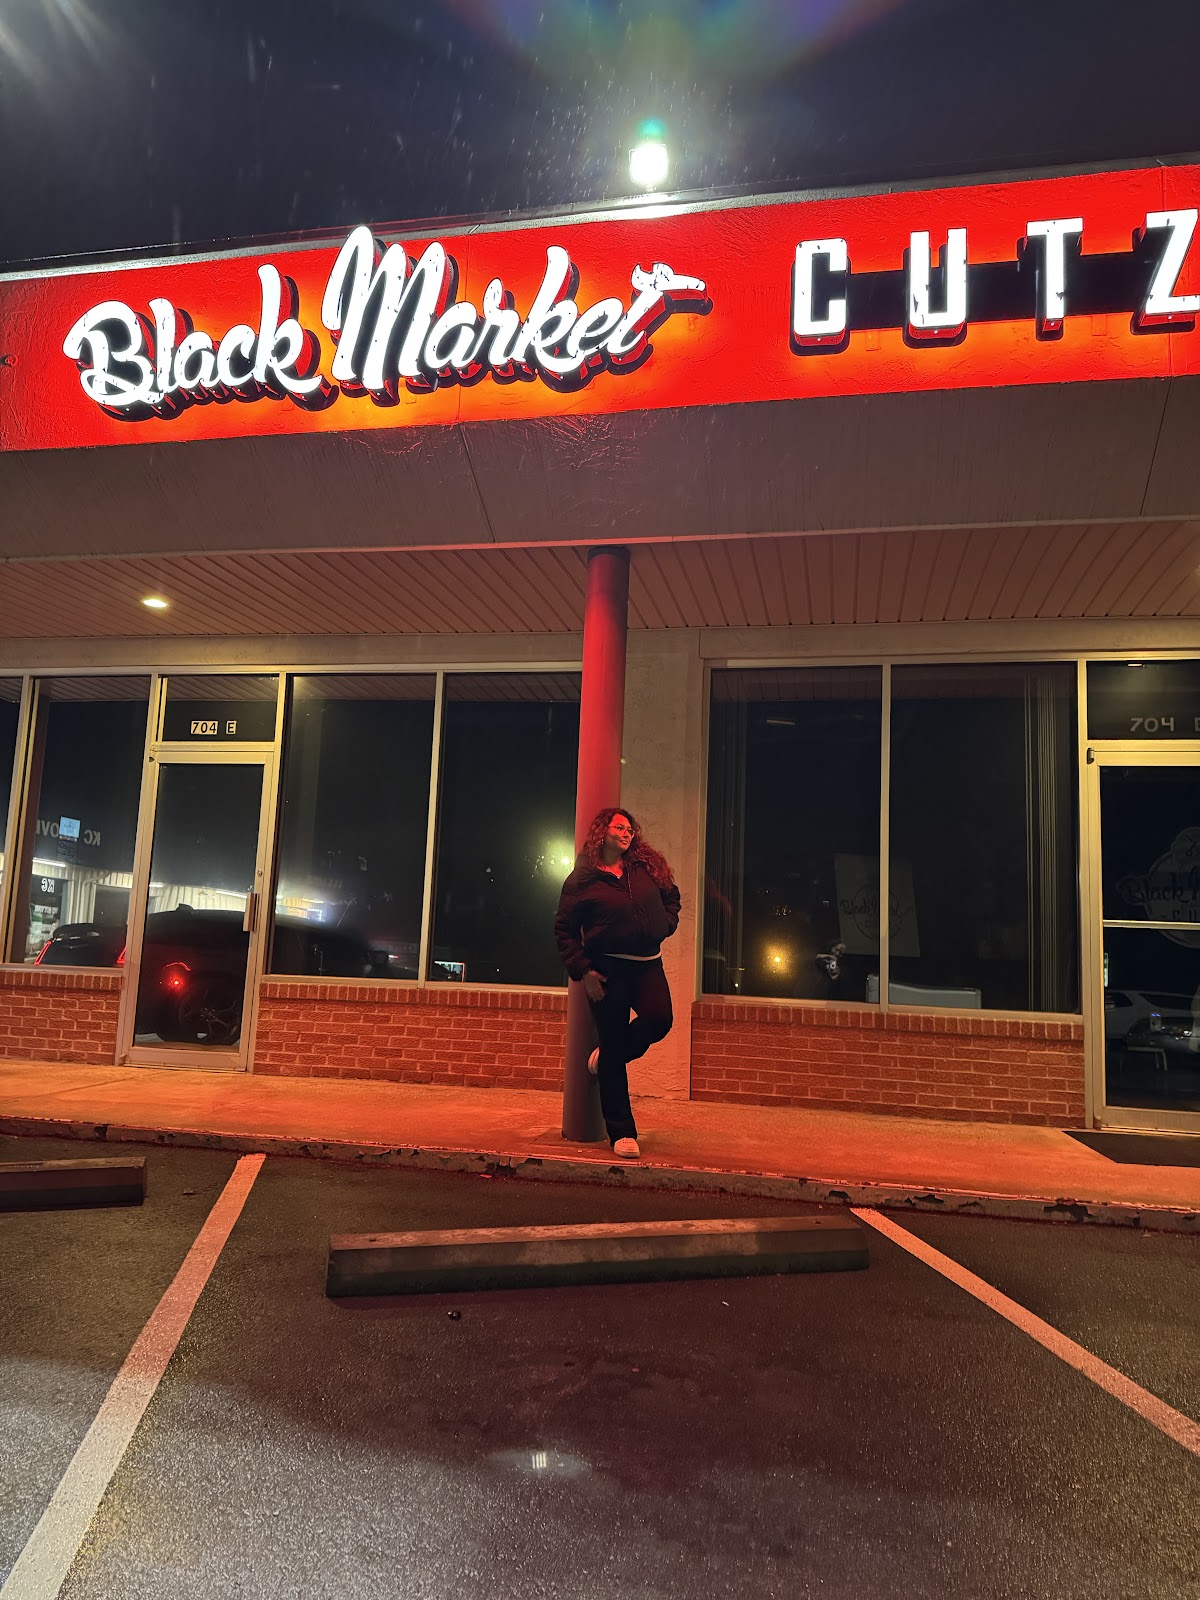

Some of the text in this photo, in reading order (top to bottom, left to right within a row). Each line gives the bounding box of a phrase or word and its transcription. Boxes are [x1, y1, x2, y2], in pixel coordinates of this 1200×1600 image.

[64, 208, 1200, 408] Black Market CUTZ
[191, 721, 236, 734] 704 E
[1130, 717, 1175, 732] 704
